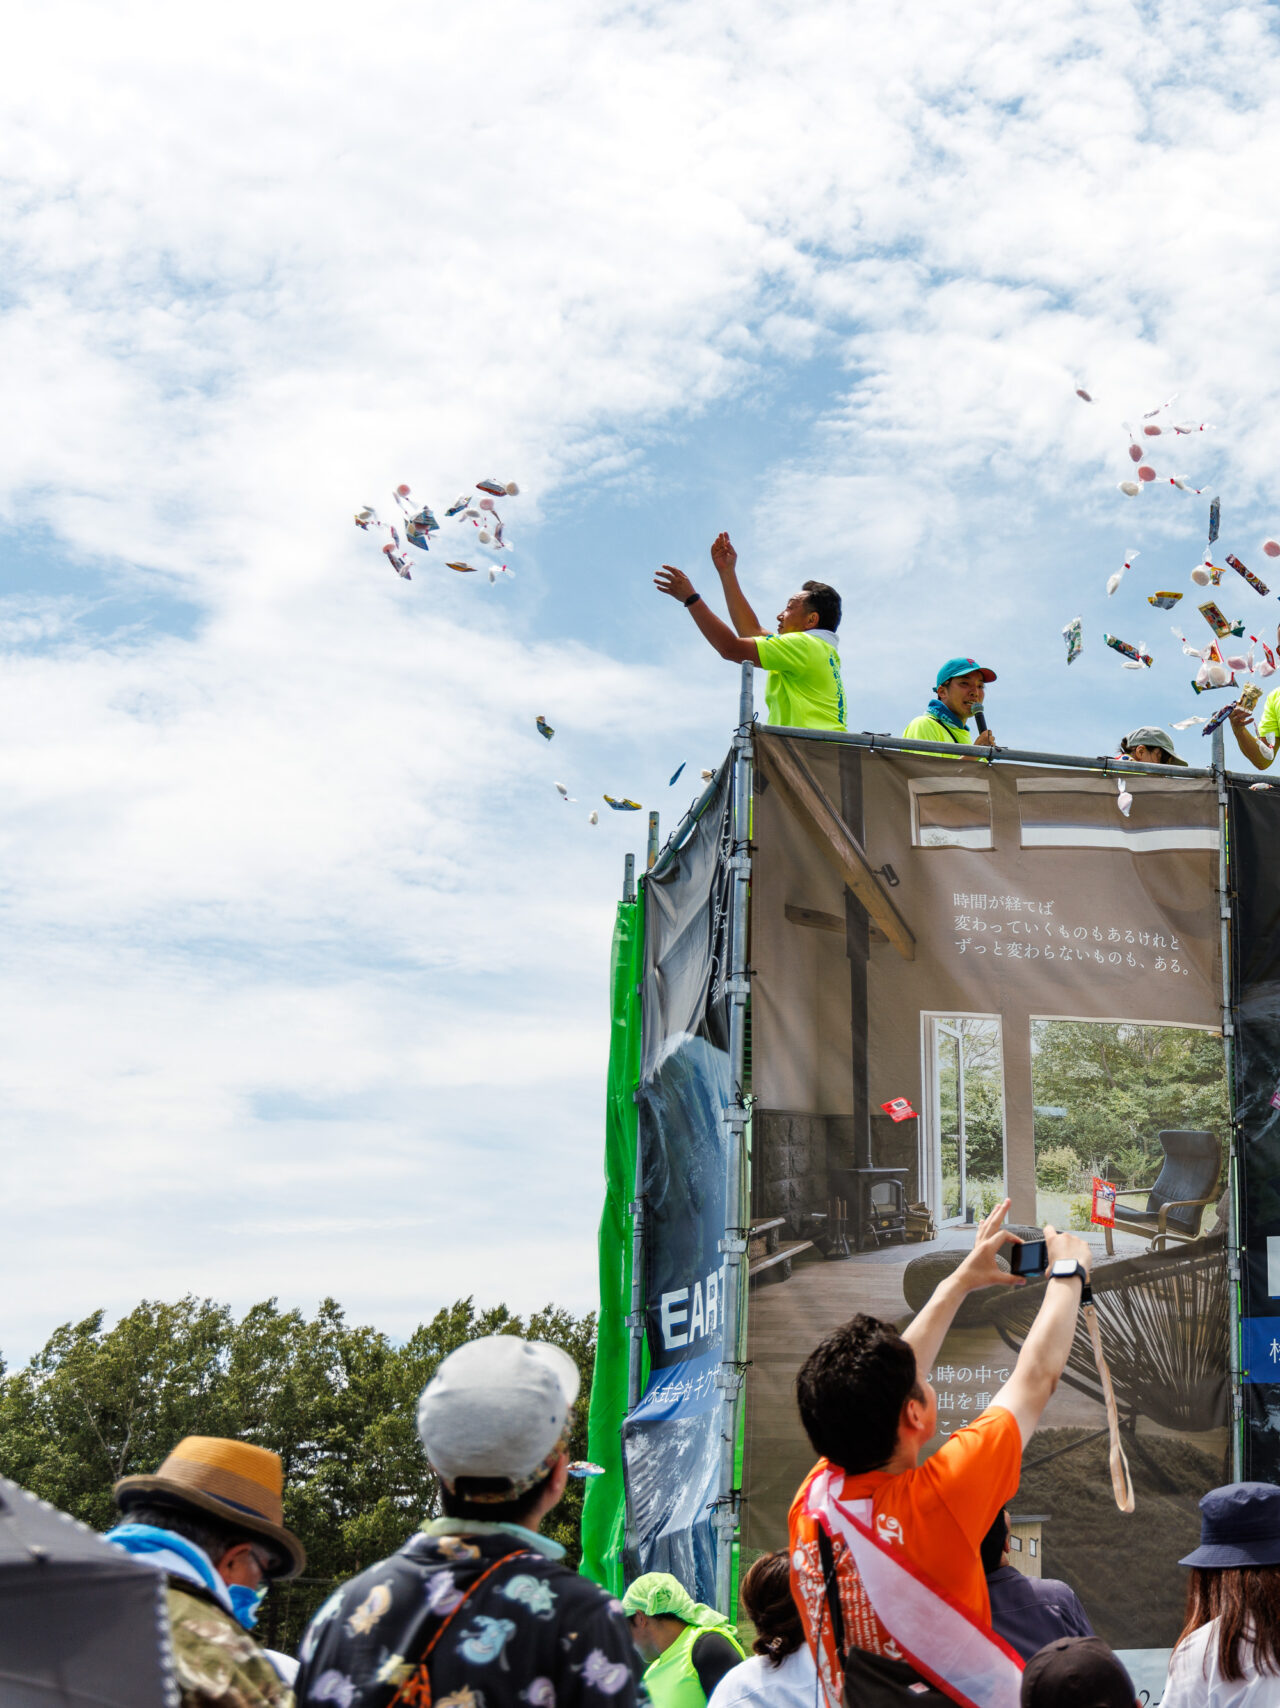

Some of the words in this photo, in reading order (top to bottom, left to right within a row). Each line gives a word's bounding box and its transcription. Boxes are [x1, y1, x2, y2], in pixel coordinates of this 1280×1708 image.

[953, 892, 1055, 916] 時間が経てば
[953, 914, 1180, 950] 変わっていくものもあるけれど
